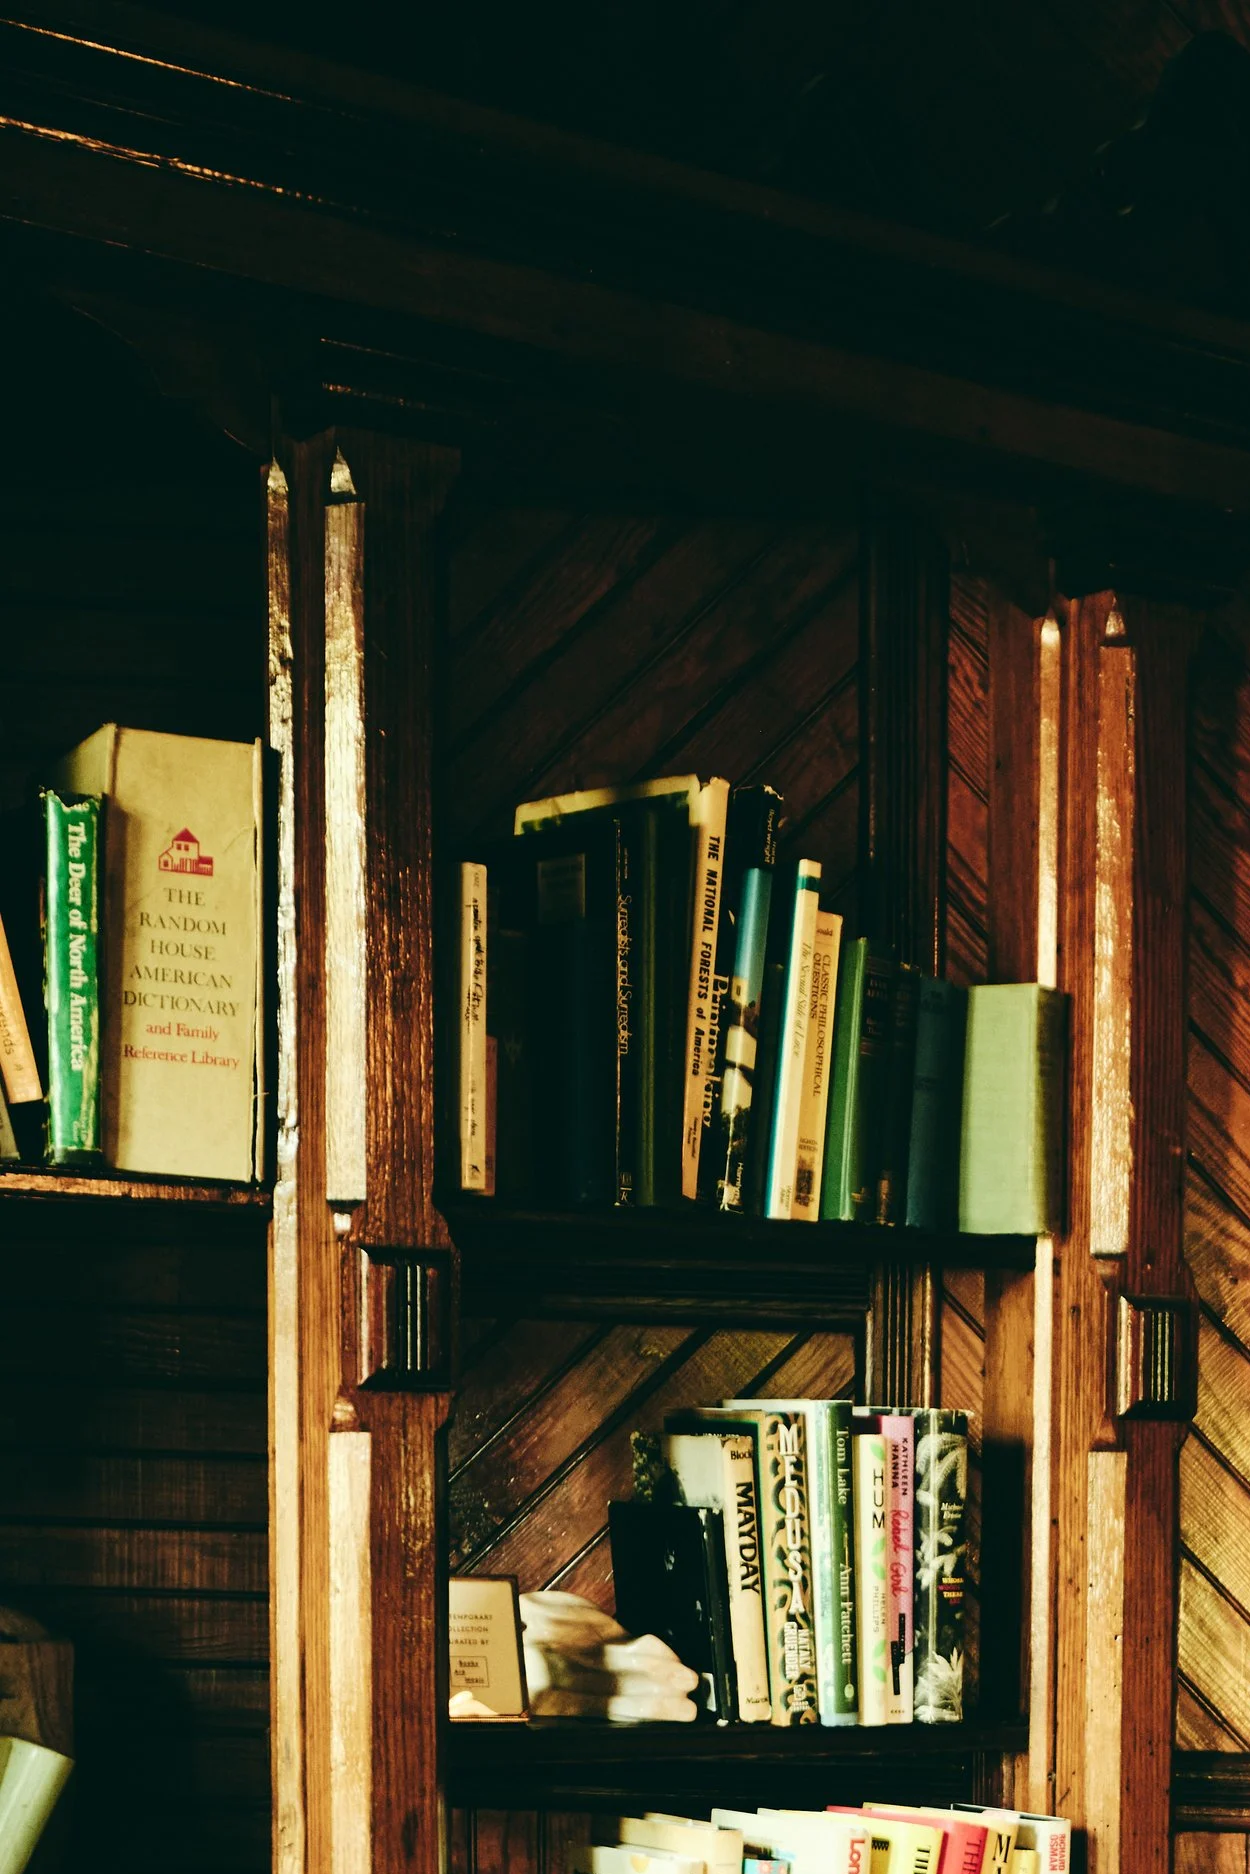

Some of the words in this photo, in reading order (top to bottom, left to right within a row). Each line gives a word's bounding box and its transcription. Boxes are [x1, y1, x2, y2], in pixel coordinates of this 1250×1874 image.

[68, 822, 86, 859] The
[707, 835, 721, 862] THE
[67, 860, 86, 906] Deer
[163, 887, 206, 906] THE
[702, 868, 718, 933] NATIONAL
[67, 907, 86, 929] of
[139, 911, 227, 936] RANDOM
[617, 894, 633, 957] Surrealists
[68, 932, 87, 988] North
[150, 939, 216, 961] HOUSE
[130, 964, 233, 989] AMERICAN
[618, 959, 633, 988] and
[697, 941, 713, 1001] FORESTS
[809, 952, 822, 1020] QUESTIONS
[818, 954, 832, 1001] CLASSIC
[123, 990, 240, 1016] DICTIONARY
[617, 989, 633, 1055] Surrealism
[695, 1007, 707, 1020] of
[69, 991, 87, 1072] America
[145, 1022, 171, 1037] and
[176, 1022, 220, 1041] Family
[812, 1004, 828, 1097] PHILOSOPHICAL
[124, 1044, 188, 1063] Reference
[190, 1050, 240, 1070] Library
[691, 1027, 705, 1077] America
[835, 1426, 851, 1462] Tom
[837, 1466, 851, 1506] Lake
[891, 1444, 899, 1489] HANNA
[901, 1437, 909, 1496] KATHLEEN
[872, 1467, 885, 1530] HUM
[735, 1481, 761, 1595] MAYDAY
[777, 1423, 805, 1614] MEDUSA
[890, 1509, 910, 1553] Rebel
[839, 1562, 853, 1596] Ann
[890, 1562, 910, 1599] Girl
[449, 1625, 489, 1633] OLLECTION
[449, 1638, 478, 1646] URATED
[840, 1599, 853, 1665] Patchett
[1049, 1834, 1059, 1872] OSMAN
[1058, 1833, 1067, 1872] RICHARD
